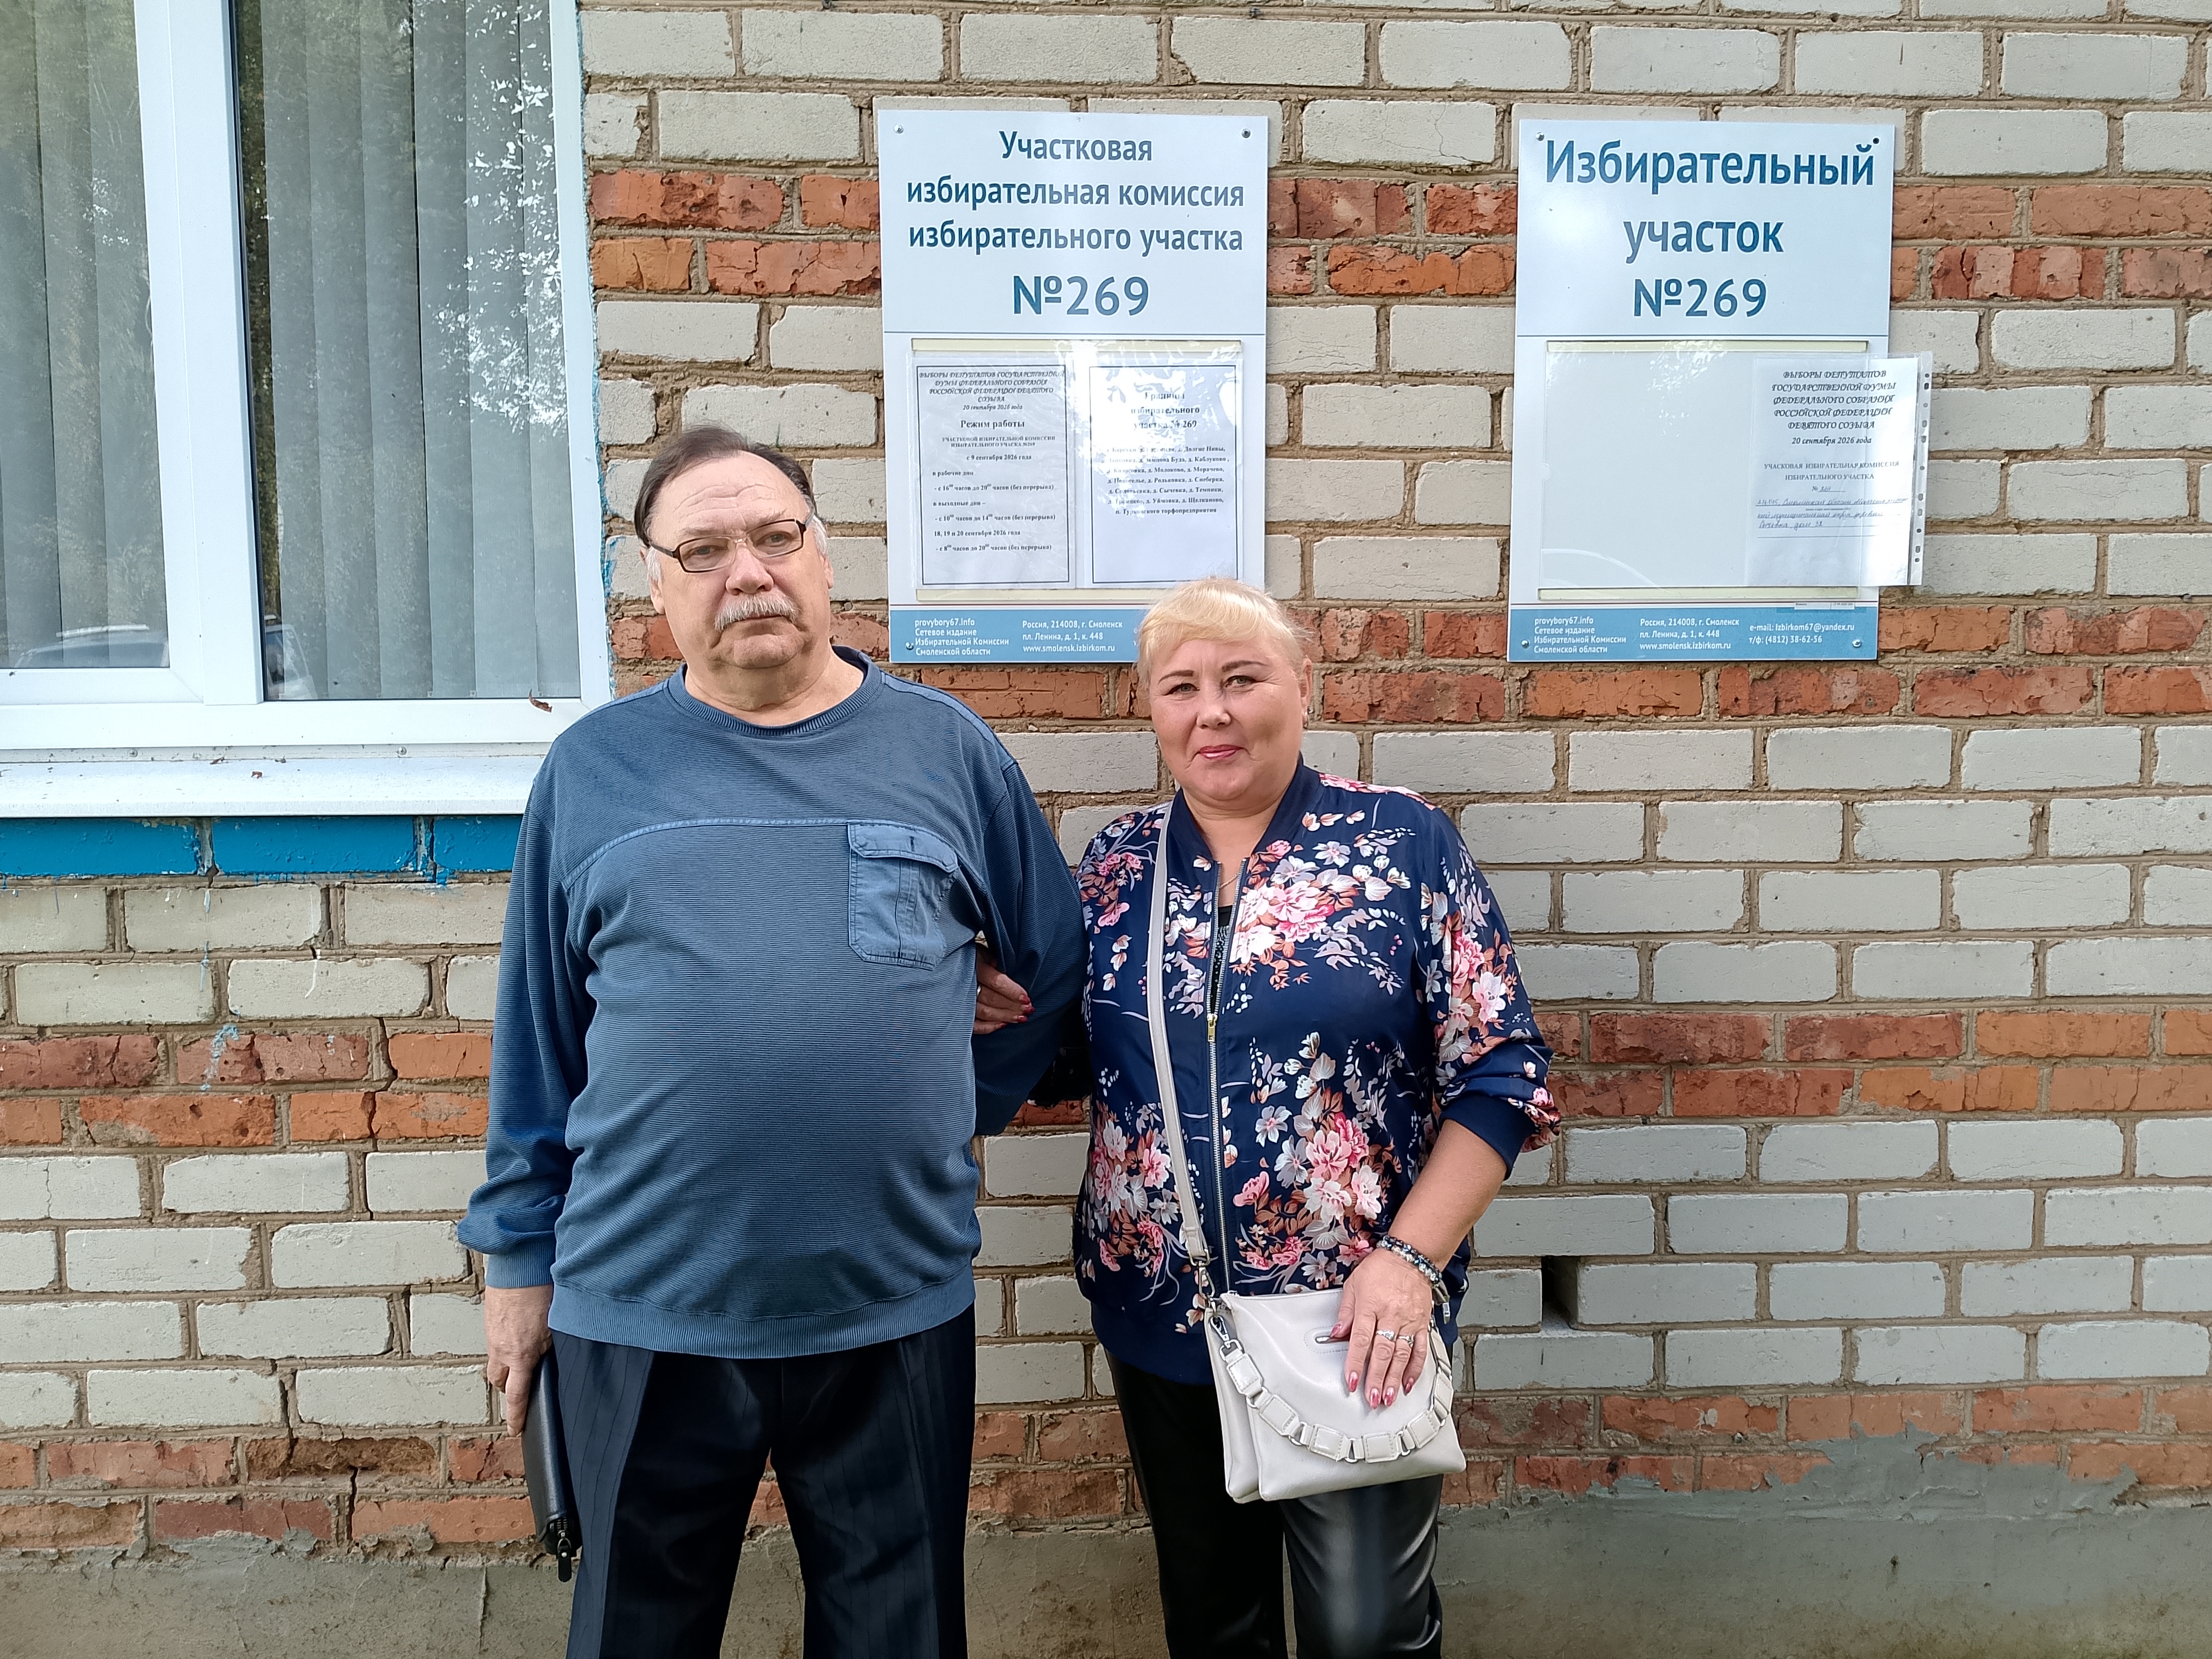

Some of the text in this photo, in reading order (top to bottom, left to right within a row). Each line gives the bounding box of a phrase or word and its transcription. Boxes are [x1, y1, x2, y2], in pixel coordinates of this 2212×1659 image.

[999, 130, 1152, 162] Участковая
[1546, 139, 1874, 194] Избирательный
[907, 175, 1244, 210] избирательная комиссия
[909, 220, 1243, 256] избирательного участка
[1623, 220, 1784, 263] участок
[1013, 275, 1149, 315] №269
[1633, 278, 1767, 317] №269
[1772, 383, 1863, 391] ГОСУДАРСТВЕННОЙ
[1846, 395, 1896, 404] СОБРАНИЯ
[1774, 408, 1893, 417] РОССИЙСКОЙ ФЕДЕРАЦИИ
[993, 420, 1025, 429] работы
[1802, 436, 1836, 446] сентября
[915, 618, 975, 627] provybory67.info
[1023, 621, 1049, 629] Россия,
[1051, 621, 1079, 629] 214008,
[1535, 617, 1594, 626] provybory67.info
[1640, 618, 1666, 627] Россия,
[1690, 630, 1696, 639] 1,
[916, 638, 971, 647] Избирательной
[1534, 636, 1589, 644] Избирательной
[1749, 636, 1764, 644] т/ф:
[1765, 635, 1788, 644] (4812)
